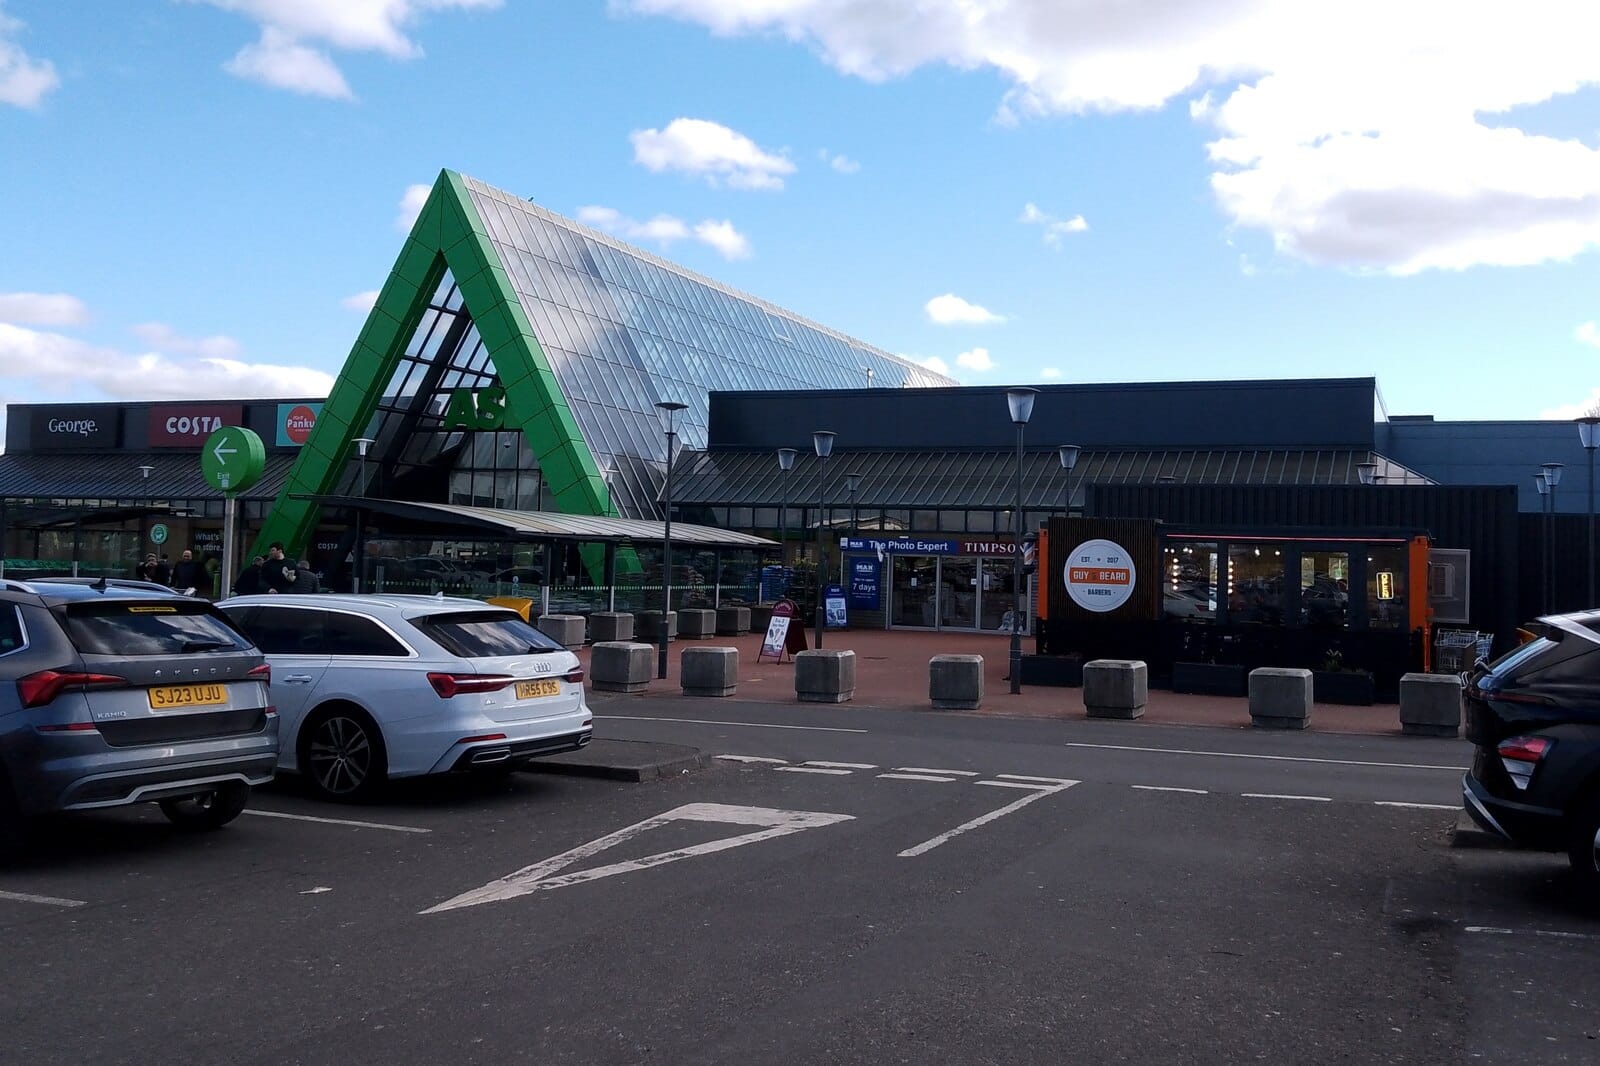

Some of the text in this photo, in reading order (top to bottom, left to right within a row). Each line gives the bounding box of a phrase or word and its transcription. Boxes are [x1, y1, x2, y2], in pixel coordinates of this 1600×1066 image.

[48, 418, 98, 437] George.
[166, 416, 222, 435] COSTA
[287, 418, 315, 428] Panku
[217, 472, 230, 480] Exit
[195, 533, 219, 541] What's
[869, 540, 948, 552] The Photo Expert
[965, 542, 1024, 554] TIMPSO
[1073, 571, 1089, 580] GUY
[1100, 572, 1126, 581] BEARD
[853, 583, 876, 593] 7 days
[1087, 588, 1112, 596] BARBERS
[155, 687, 221, 704] SJ23 UJU
